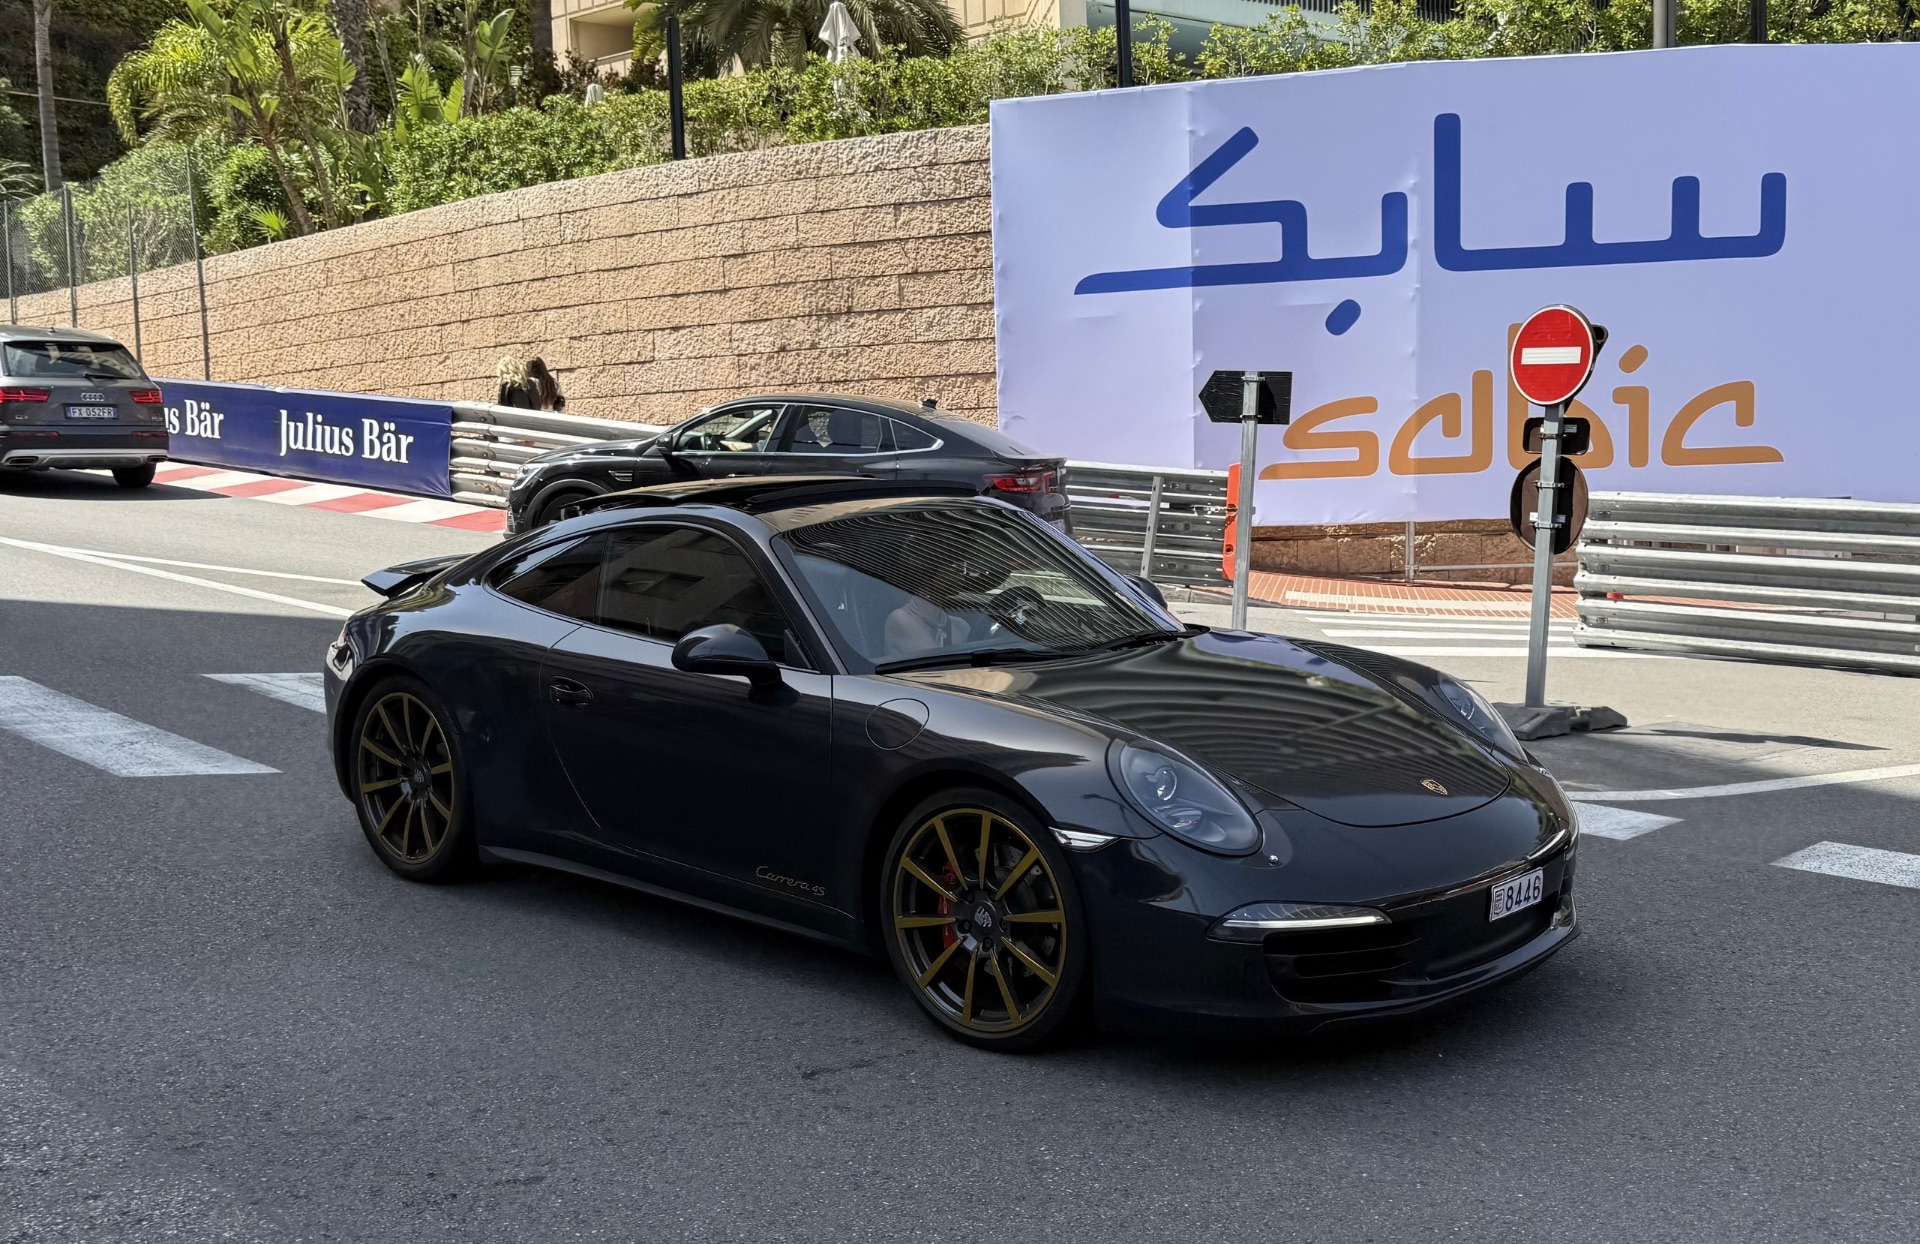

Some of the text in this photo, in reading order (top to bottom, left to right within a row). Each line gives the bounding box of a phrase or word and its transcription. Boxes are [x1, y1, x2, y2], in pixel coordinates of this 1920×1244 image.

[1073, 113, 1787, 336] سابك
[184, 399, 225, 440] Bär
[1258, 322, 1784, 480] sabic
[279, 409, 414, 464] Julius Bär
[755, 865, 810, 891] Carrera
[1505, 875, 1541, 912] 8446
